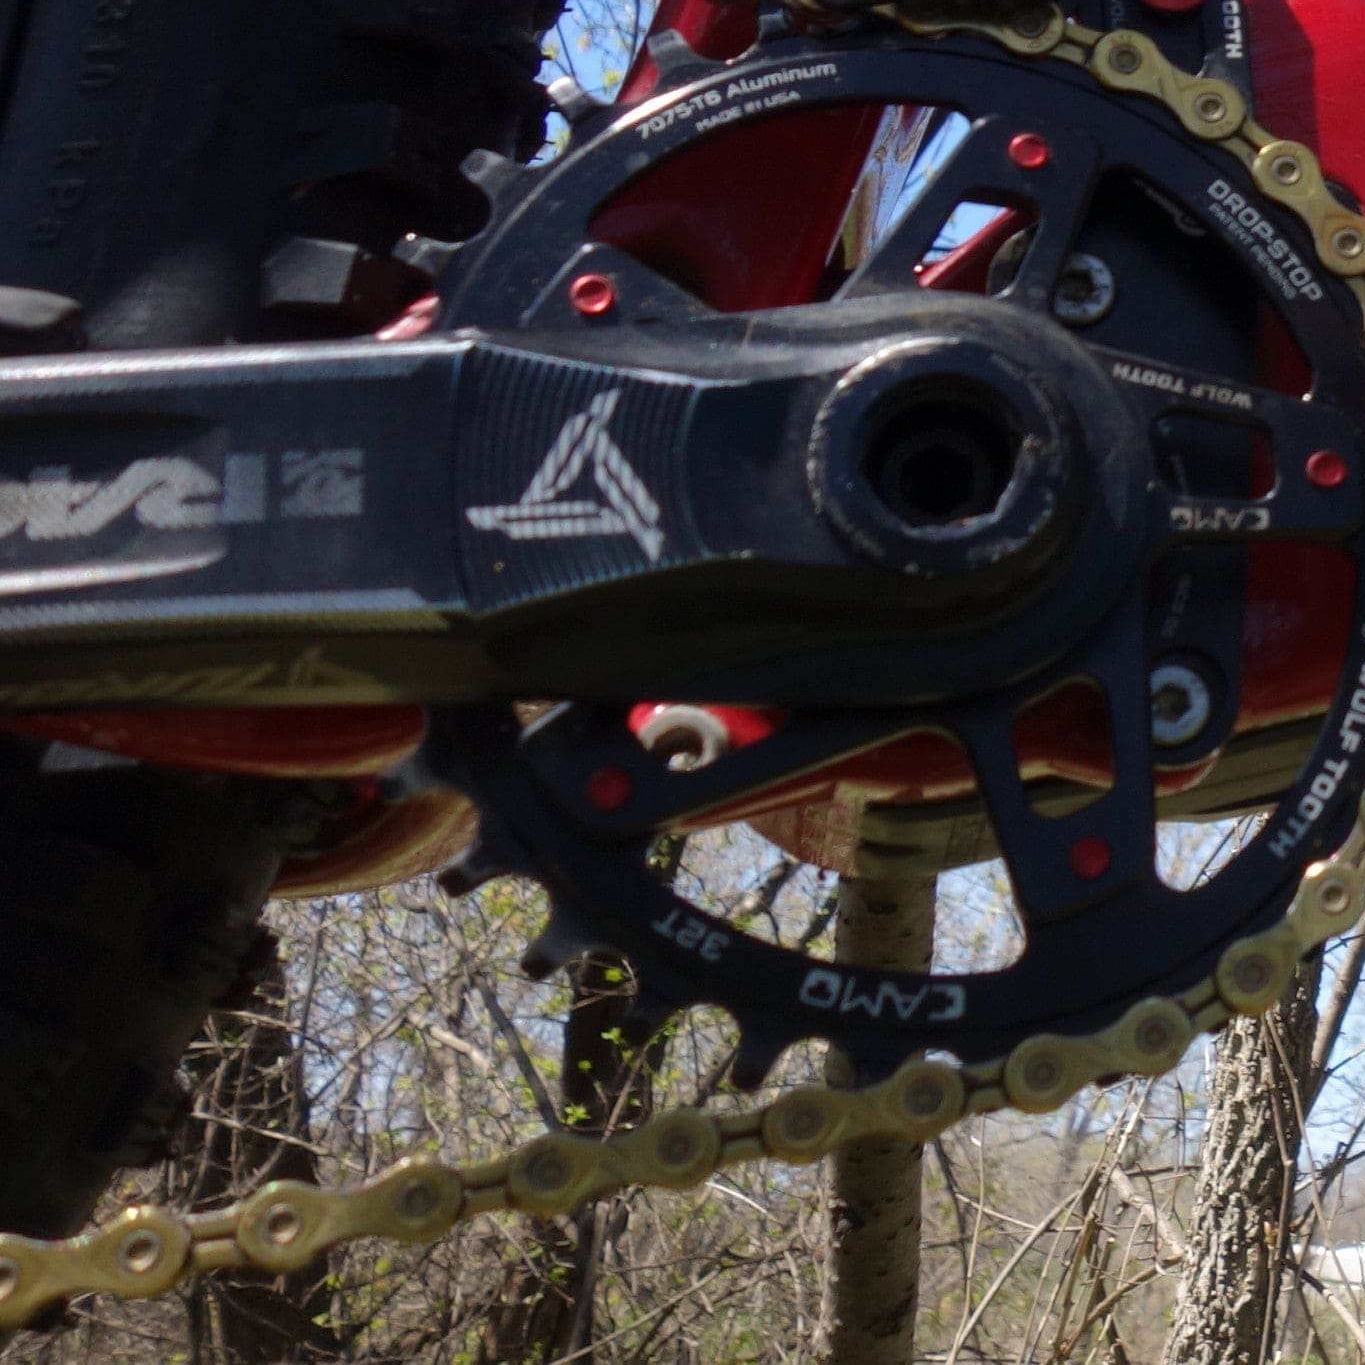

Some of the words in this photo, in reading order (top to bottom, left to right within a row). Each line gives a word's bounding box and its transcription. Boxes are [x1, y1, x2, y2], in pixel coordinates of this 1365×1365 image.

[635, 89, 723, 140] 7075-T6
[726, 62, 838, 100] Aluminum
[696, 105, 744, 133] MADE
[763, 89, 802, 109] USA
[1111, 361, 1187, 394] TOOTH
[1189, 383, 1252, 410] WOLF
[1170, 505, 1271, 531] CAMO
[1266, 757, 1350, 860] TOOTH
[650, 907, 732, 963] 32T
[800, 966, 967, 1023] CAMO
